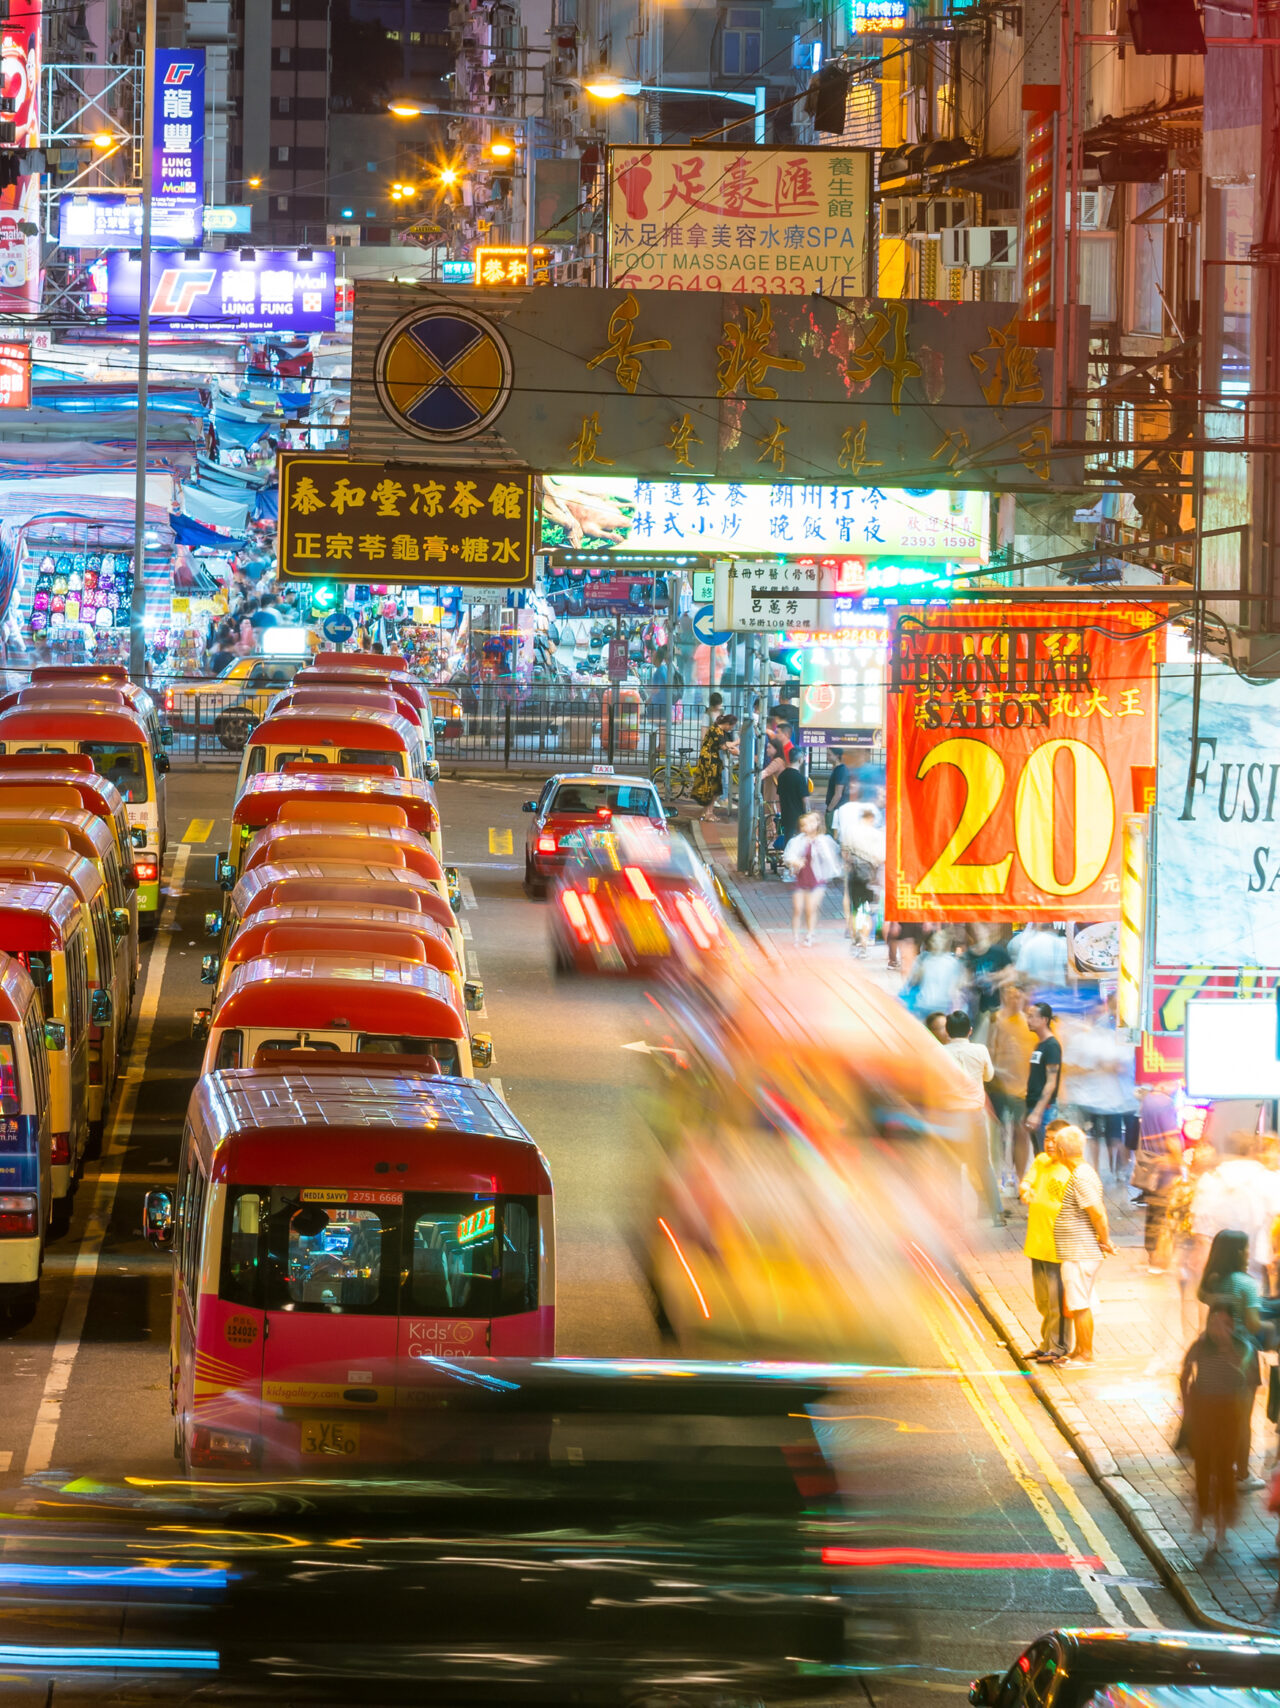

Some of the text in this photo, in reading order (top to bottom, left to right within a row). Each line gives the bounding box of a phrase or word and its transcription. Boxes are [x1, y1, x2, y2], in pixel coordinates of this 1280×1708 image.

[161, 157, 192, 168] LUNG
[161, 167, 192, 178] FUNG
[828, 157, 854, 218] 養生館
[614, 253, 855, 272] FOOT MASSAGE BEAUTY
[731, 275, 806, 296] 4333
[222, 303, 294, 315] LUNG FUNG
[632, 511, 887, 543] 特式小炒 晚飯宵夜
[901, 536, 976, 548] 2393 1598
[924, 698, 1052, 729] SALON
[594, 765, 613, 773] TAXI
[914, 736, 1116, 896] 20
[303, 1191, 403, 1203] MEDIA SAVVY 2751 6666
[408, 1343, 471, 1363] Gallery
[266, 1383, 340, 1400] kidsgallery.com
